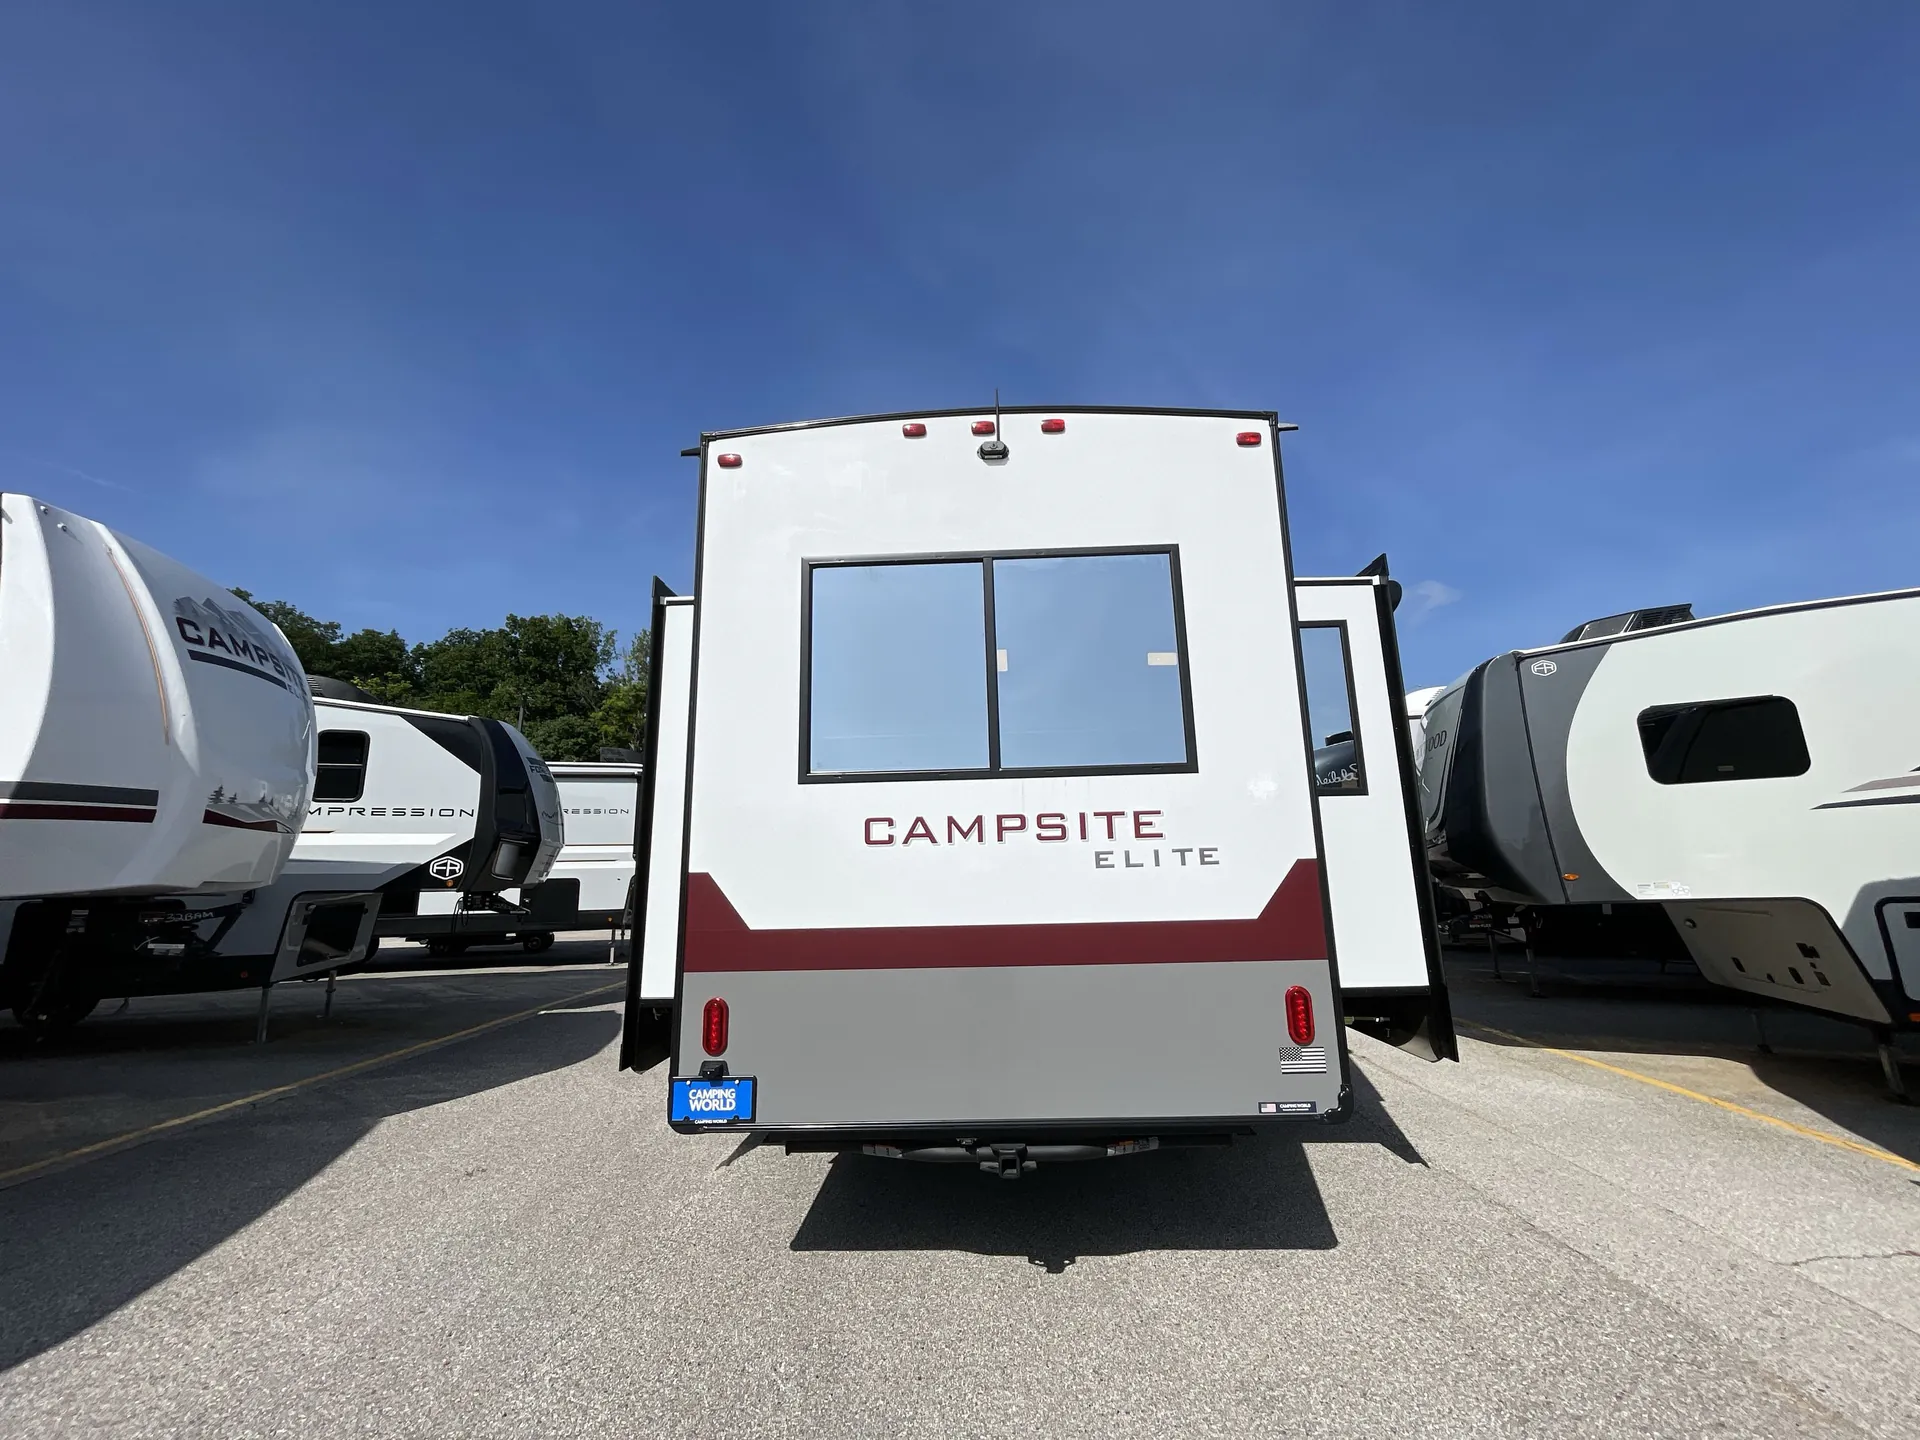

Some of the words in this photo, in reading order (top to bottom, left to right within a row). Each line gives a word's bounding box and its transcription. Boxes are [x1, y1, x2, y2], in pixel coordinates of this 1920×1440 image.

[864, 810, 1165, 846] CAMPSITE
[1095, 847, 1220, 869] ELITE
[688, 1088, 736, 1099] CAMPING
[689, 1099, 736, 1111] WORLD
